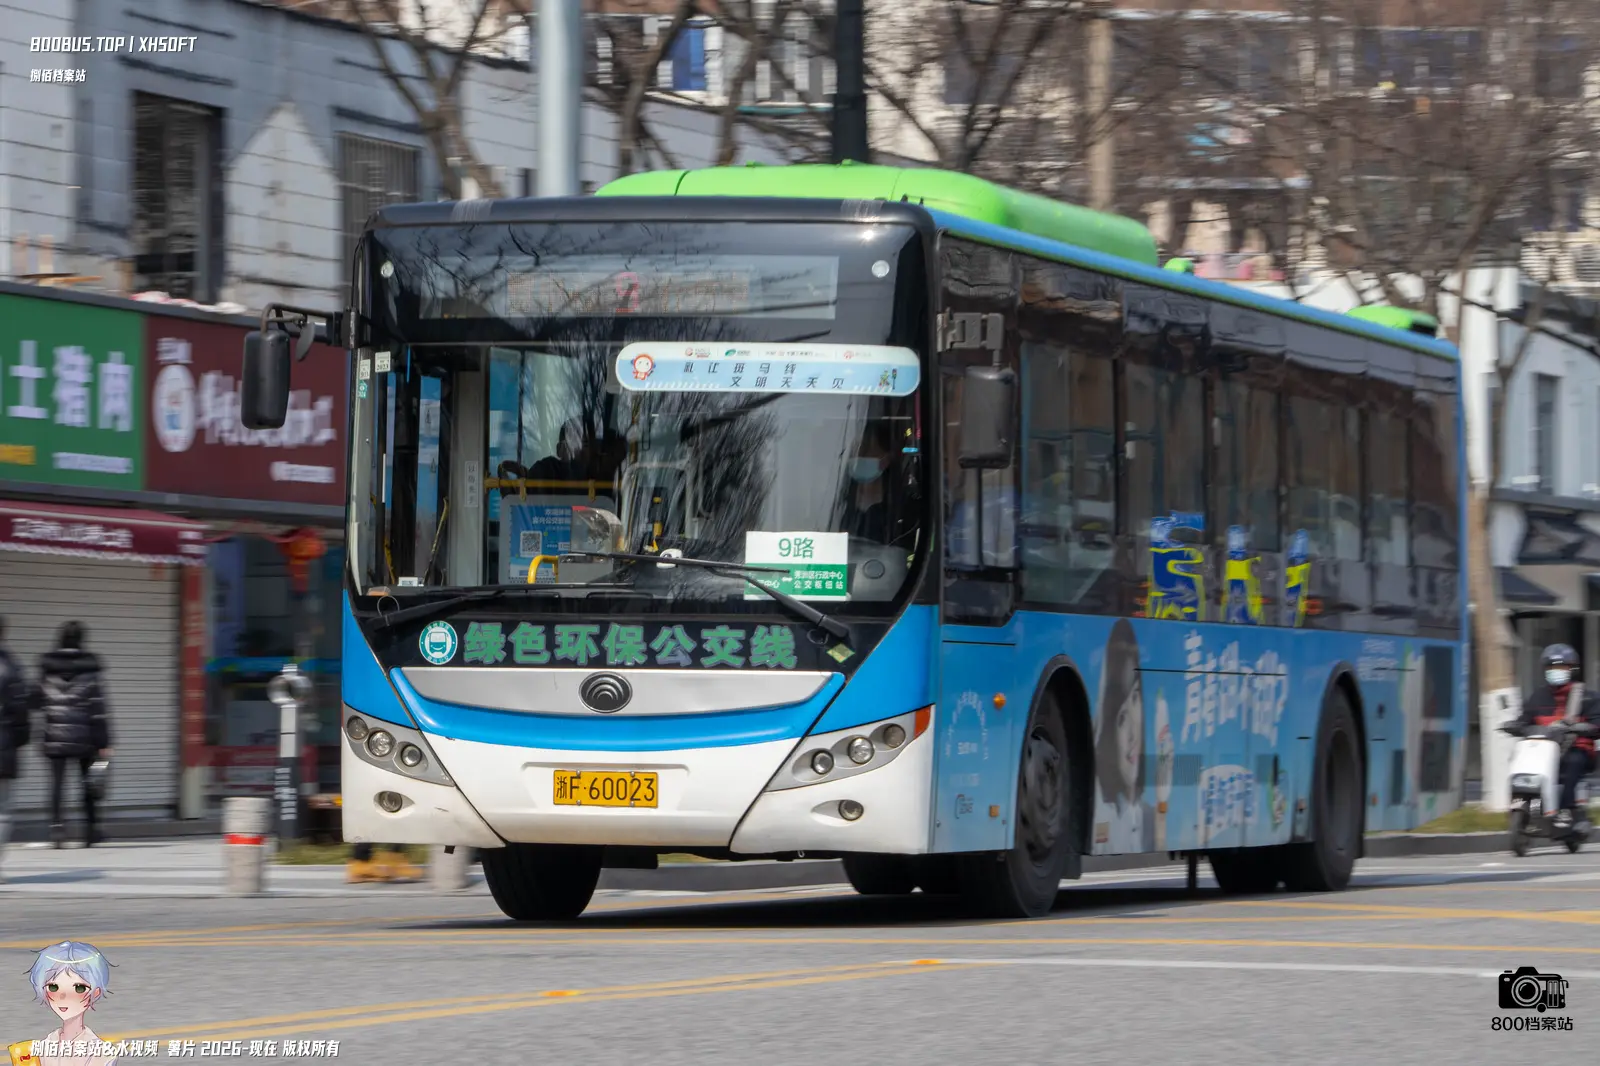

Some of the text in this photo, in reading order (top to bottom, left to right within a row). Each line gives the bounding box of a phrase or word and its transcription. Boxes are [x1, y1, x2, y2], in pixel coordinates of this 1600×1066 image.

[778, 537, 815, 558] 9路
[463, 622, 796, 668] 绿色环保公交线
